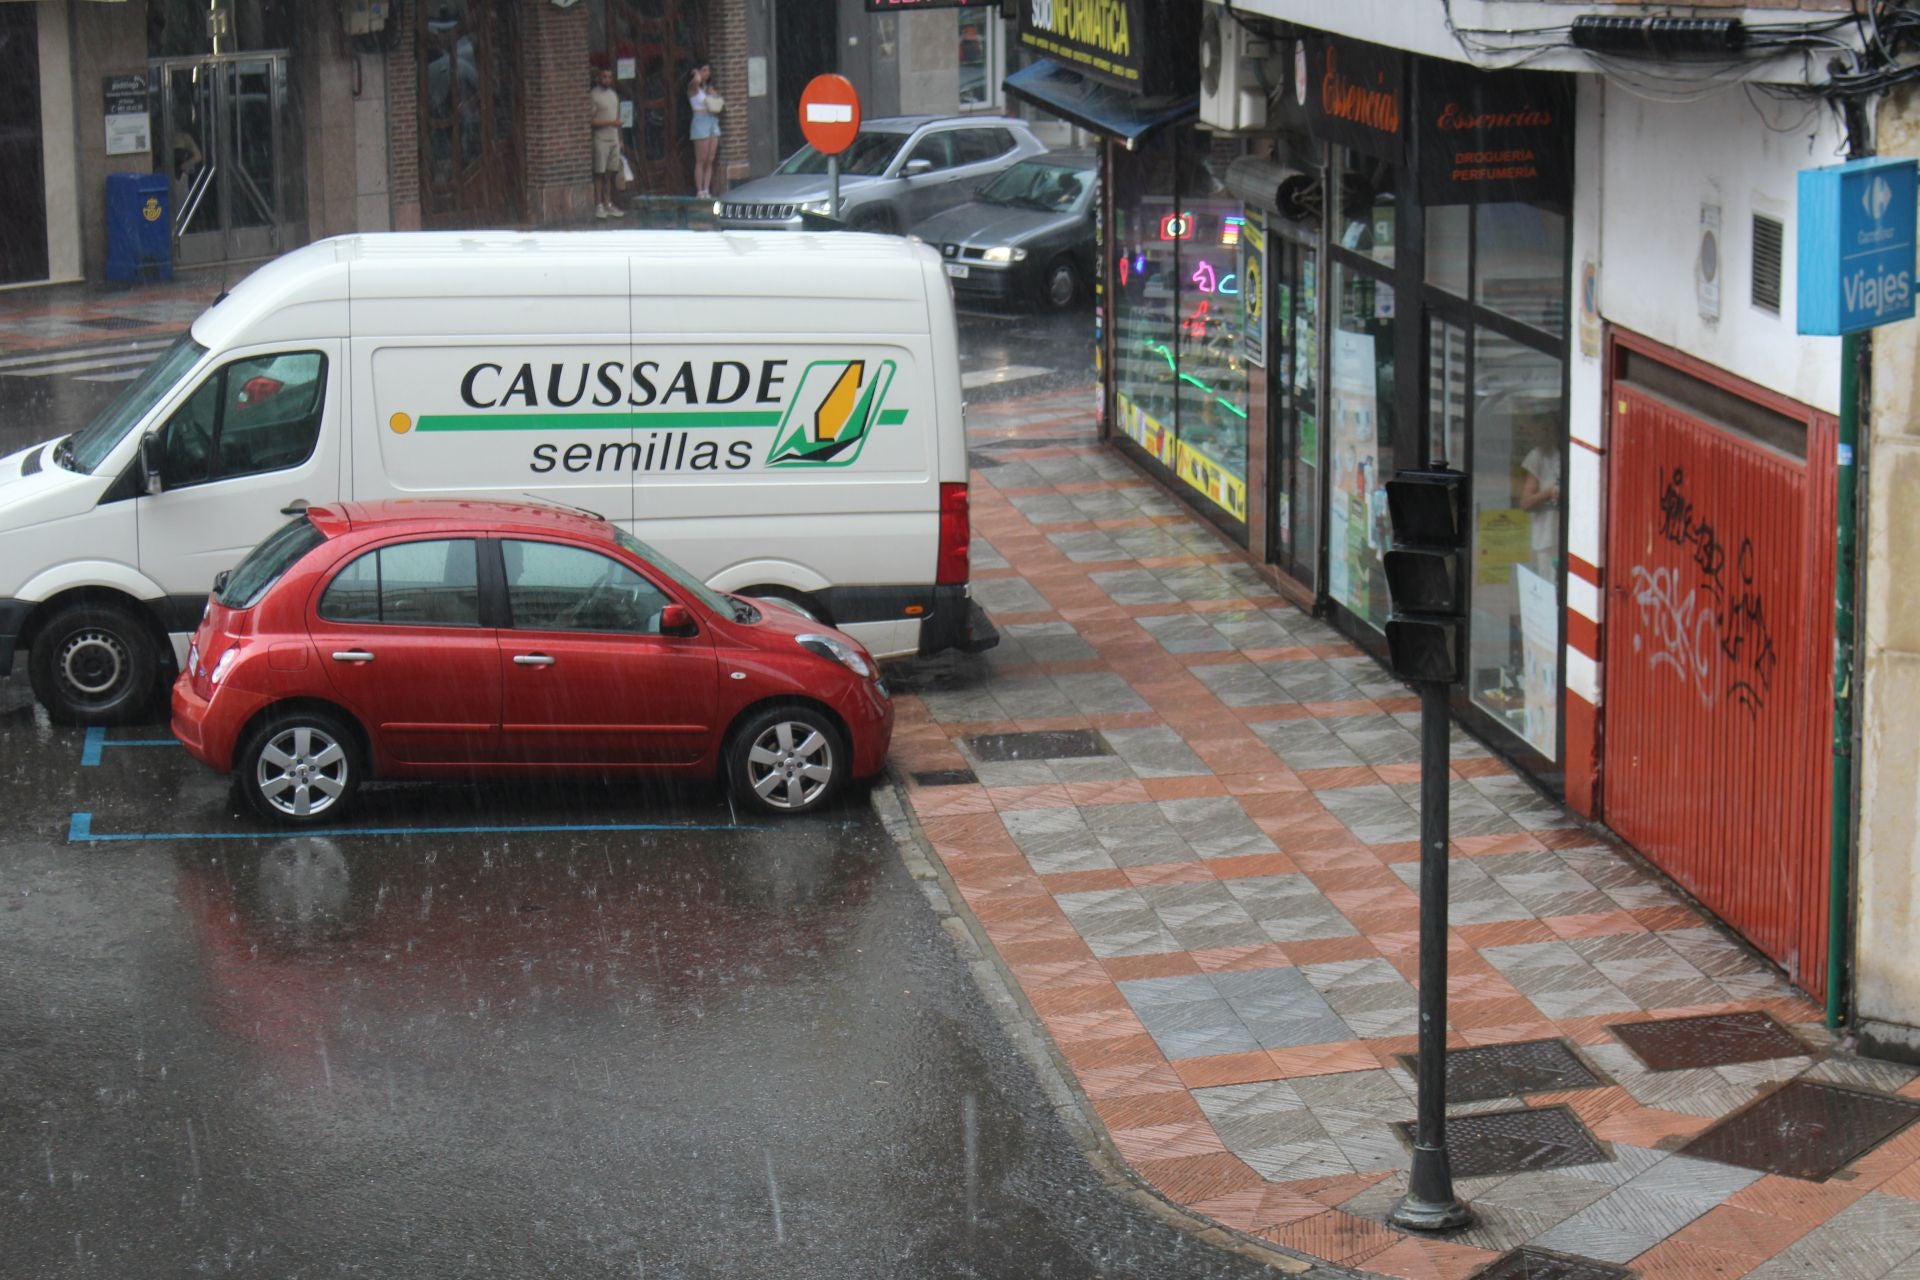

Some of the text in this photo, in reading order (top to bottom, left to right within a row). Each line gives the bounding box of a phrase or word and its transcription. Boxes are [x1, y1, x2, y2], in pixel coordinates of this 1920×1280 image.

[1322, 45, 1399, 134] Essencias
[1437, 102, 1552, 129] Essencias
[1843, 264, 1909, 316] Viajes
[460, 359, 788, 408] CAUSSADE
[530, 432, 753, 473] semillas
